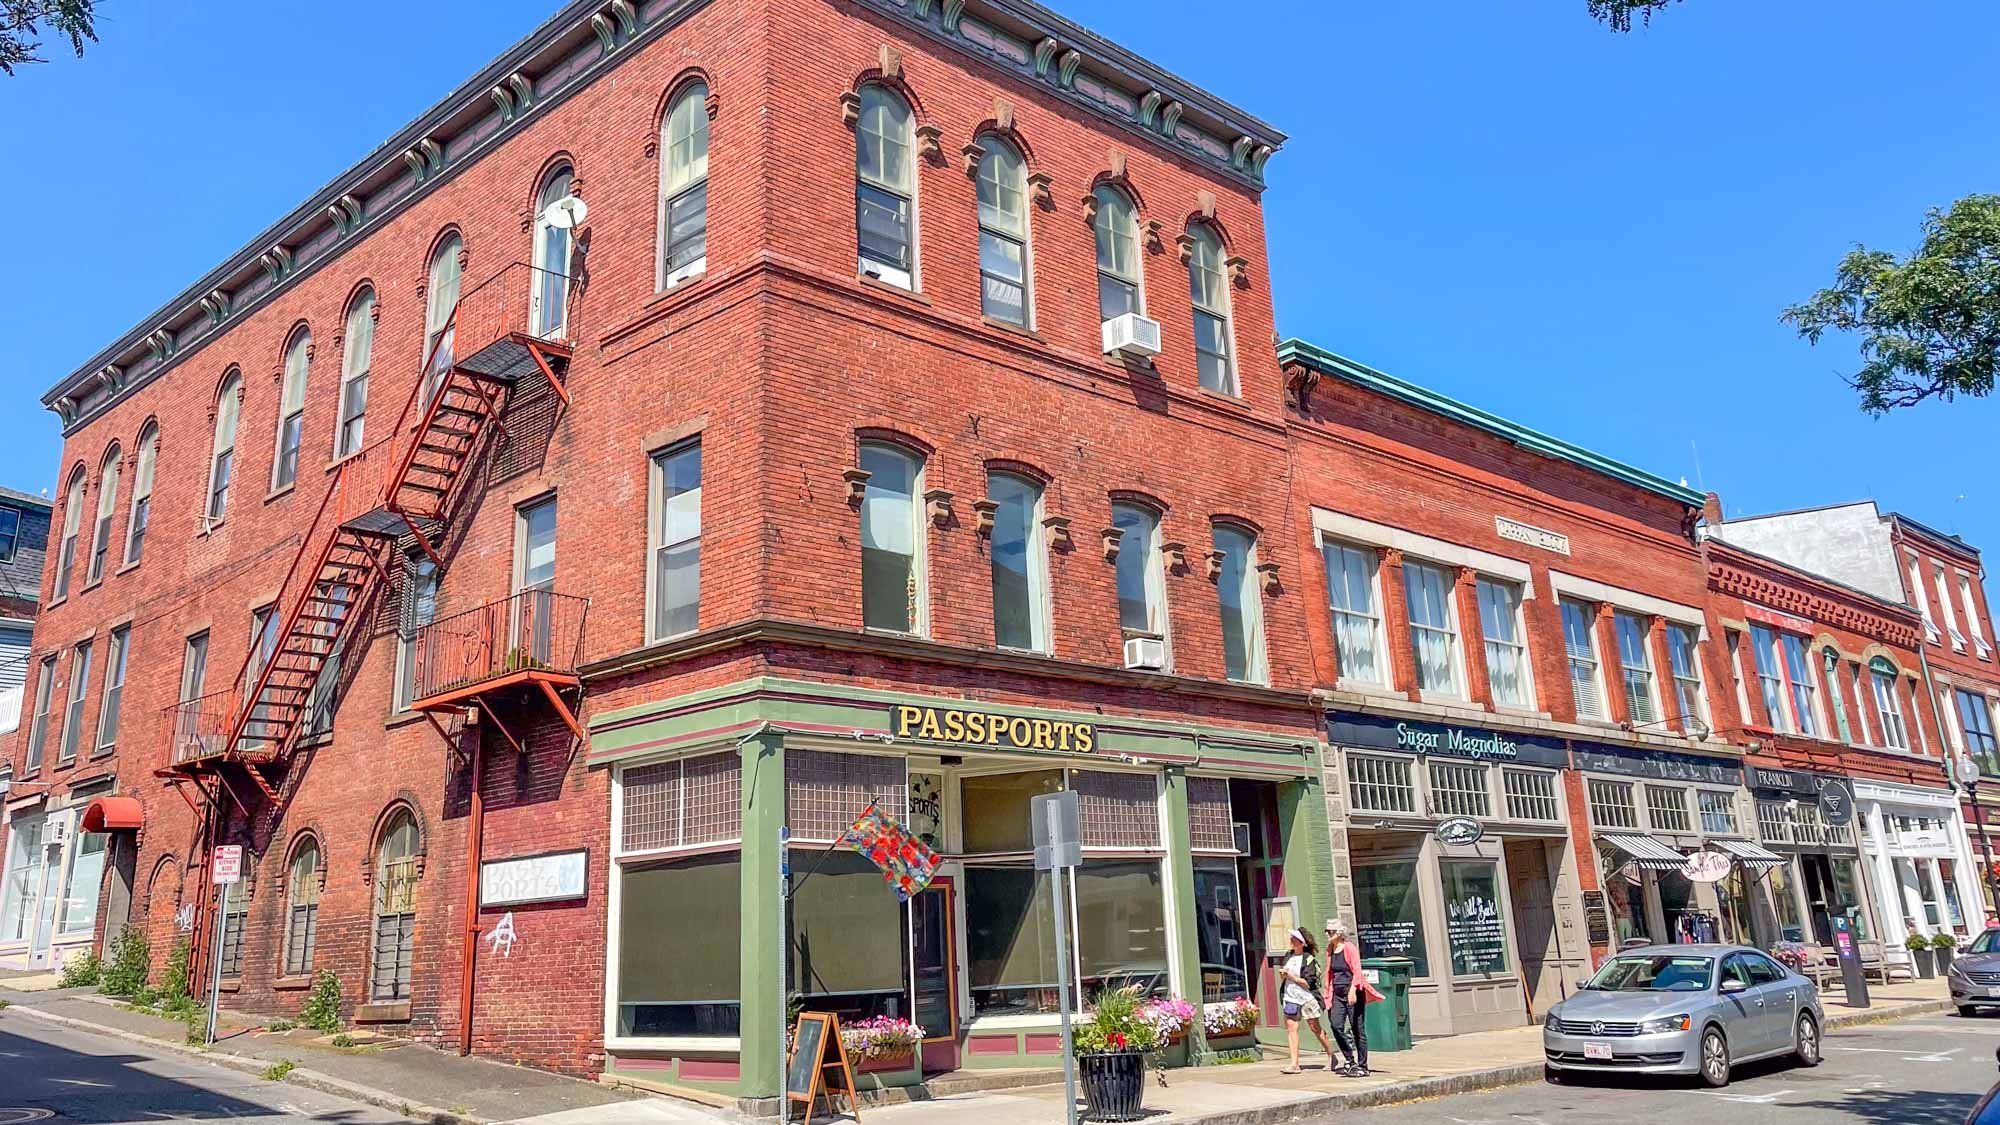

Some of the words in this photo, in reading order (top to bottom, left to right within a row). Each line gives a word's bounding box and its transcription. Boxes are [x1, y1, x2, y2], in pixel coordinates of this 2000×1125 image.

[898, 705, 1094, 753] PASSPORTS
[1397, 722, 1440, 753] Sugar
[1447, 728, 1517, 759] Magnolias
[1757, 770, 1793, 787] FRANKLIN
[1709, 854, 1730, 871] This
[1837, 917, 1845, 929] P
